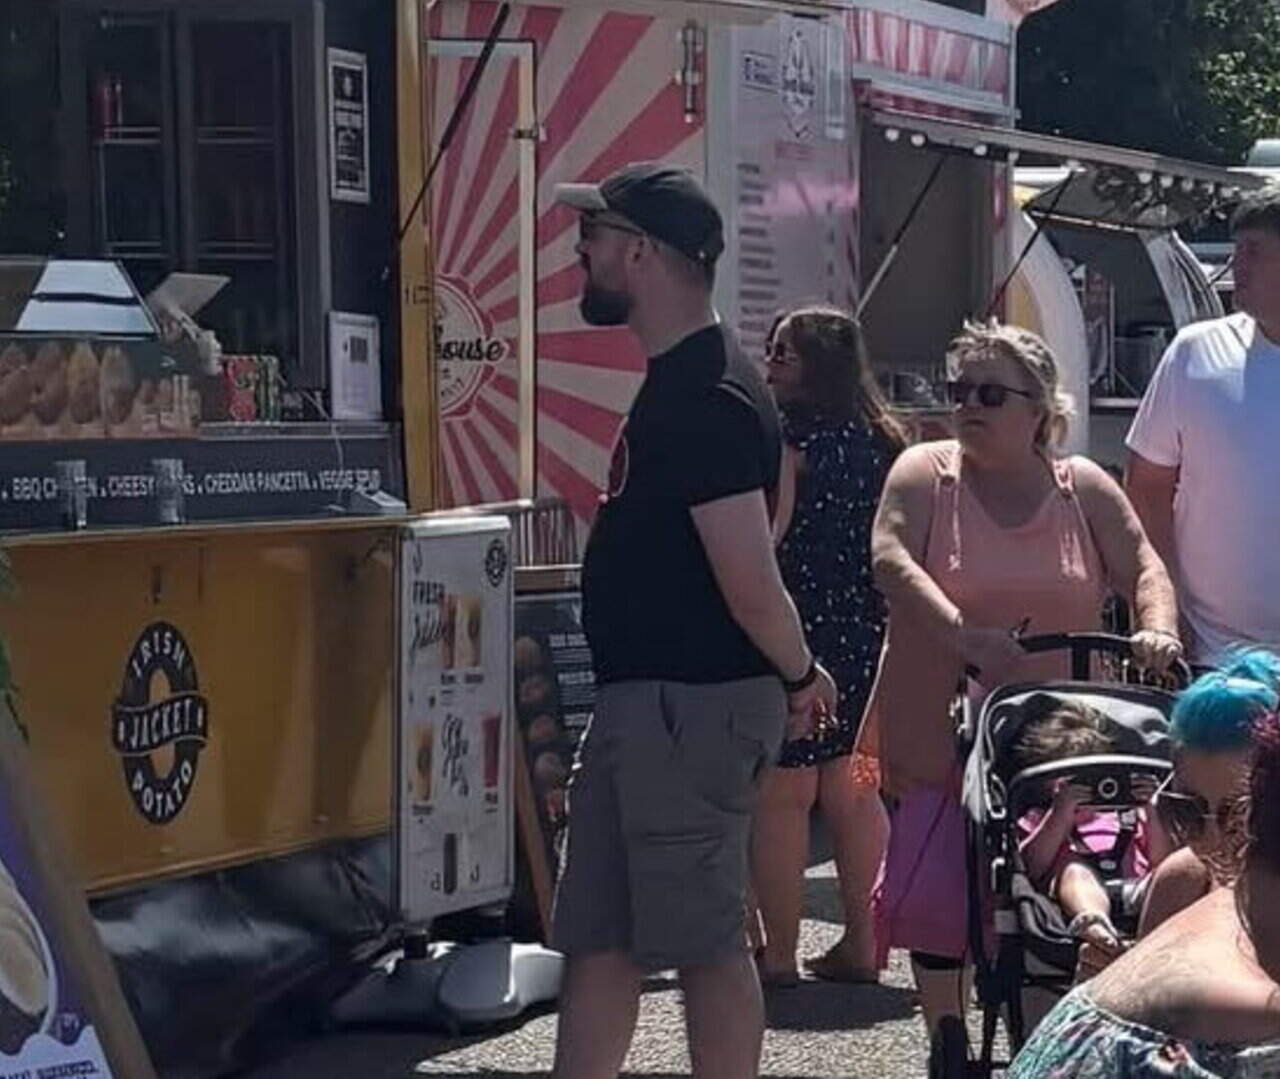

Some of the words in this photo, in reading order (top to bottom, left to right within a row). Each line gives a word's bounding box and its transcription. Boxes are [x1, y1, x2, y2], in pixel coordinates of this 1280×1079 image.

[12, 477, 41, 501] BBQ
[108, 474, 154, 498] CHEESY
[132, 631, 185, 677] IRISH
[130, 698, 192, 749] JACKET
[132, 760, 193, 817] POTATO
